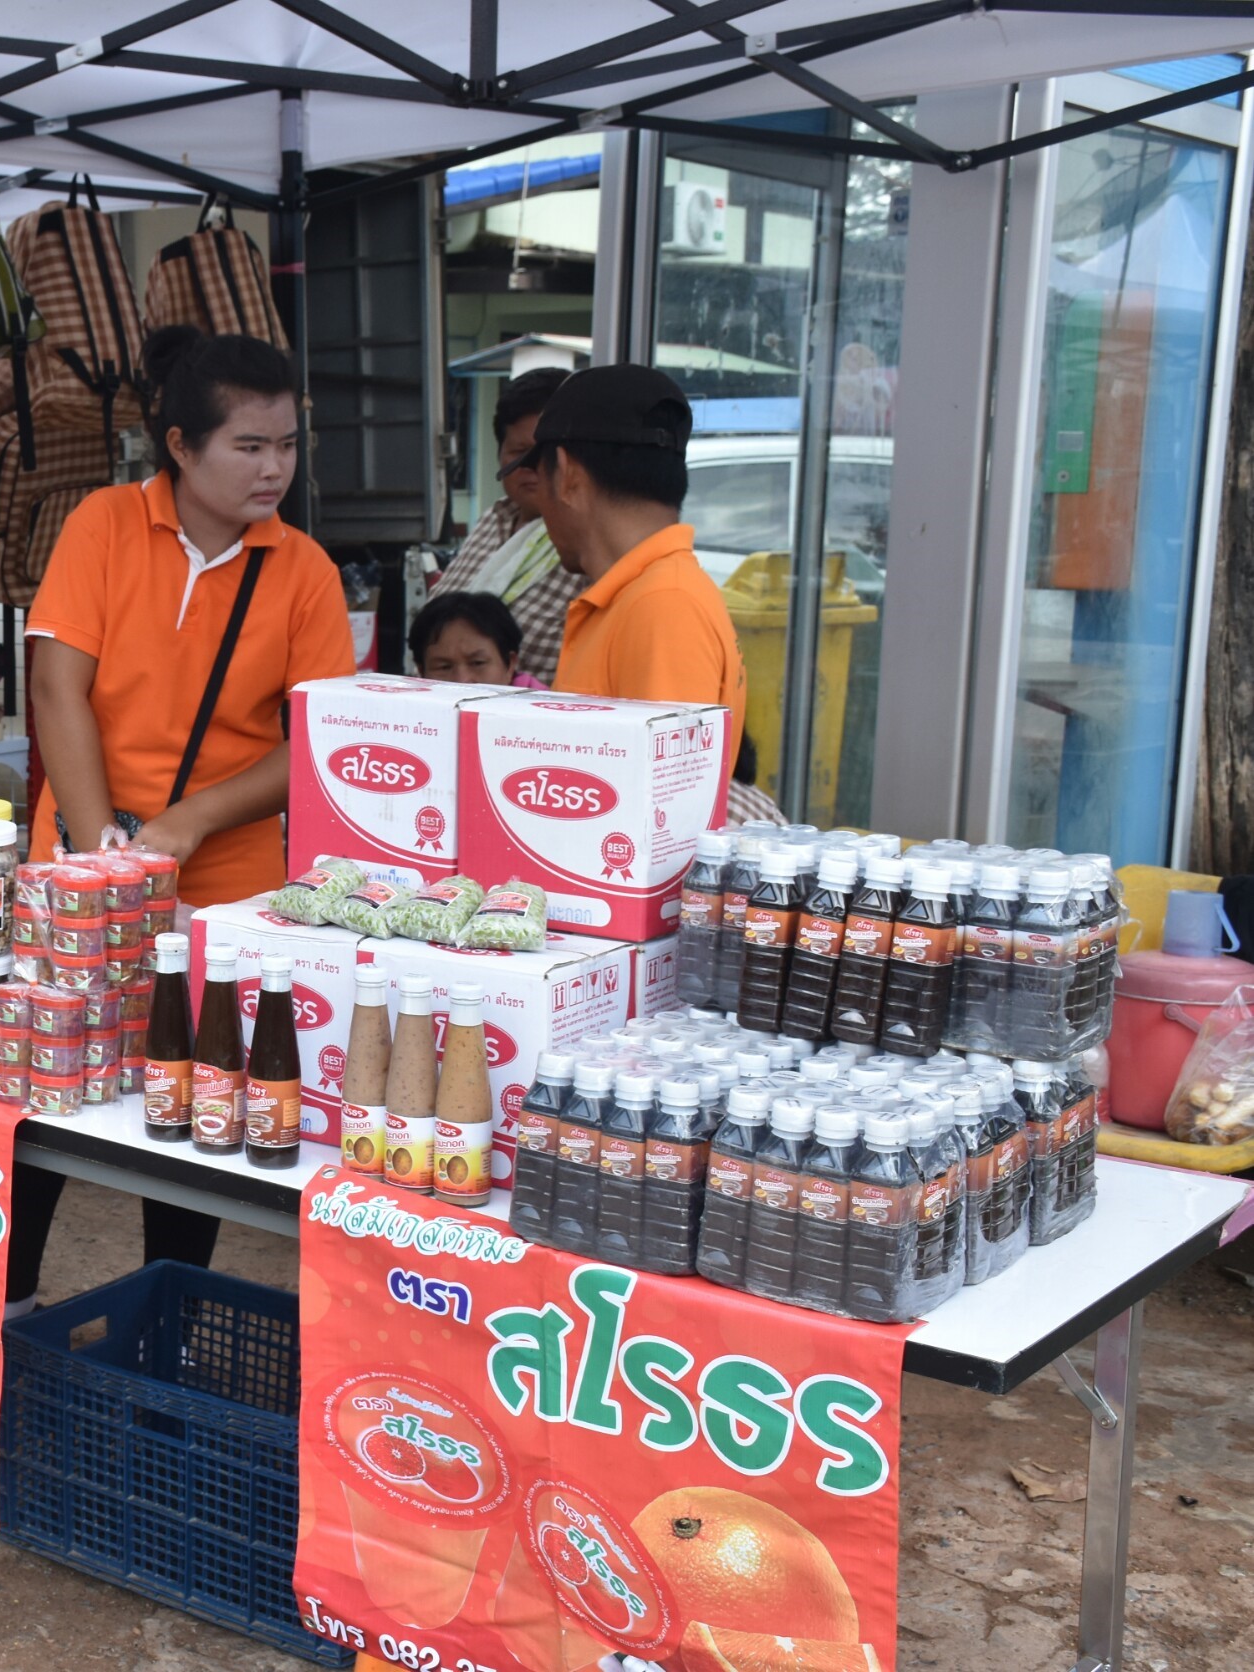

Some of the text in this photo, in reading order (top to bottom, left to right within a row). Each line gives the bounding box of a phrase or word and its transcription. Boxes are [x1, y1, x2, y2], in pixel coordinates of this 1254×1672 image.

[393, 724, 409, 734] ตรา
[575, 745, 593, 755] ตรา
[341, 747, 416, 787] สโรธร
[517, 770, 601, 812] สโรธร
[420, 815, 441, 827] BEST
[607, 842, 629, 854] BEST
[607, 852, 628, 860] QUALITY
[294, 958, 311, 970] ตรา
[496, 992, 525, 1009] สโรธร
[323, 1055, 344, 1067] BEST
[323, 1064, 344, 1073] QUALITY
[507, 1093, 522, 1105] BES
[387, 1267, 472, 1324] ตรา
[485, 1263, 889, 1497] สโรธร
[352, 1396, 394, 1413] ตรา
[381, 1413, 482, 1467] สโรธร
[554, 1496, 587, 1529] ตรา
[566, 1525, 648, 1617] สโรธร
[305, 1595, 366, 1649] โทร
